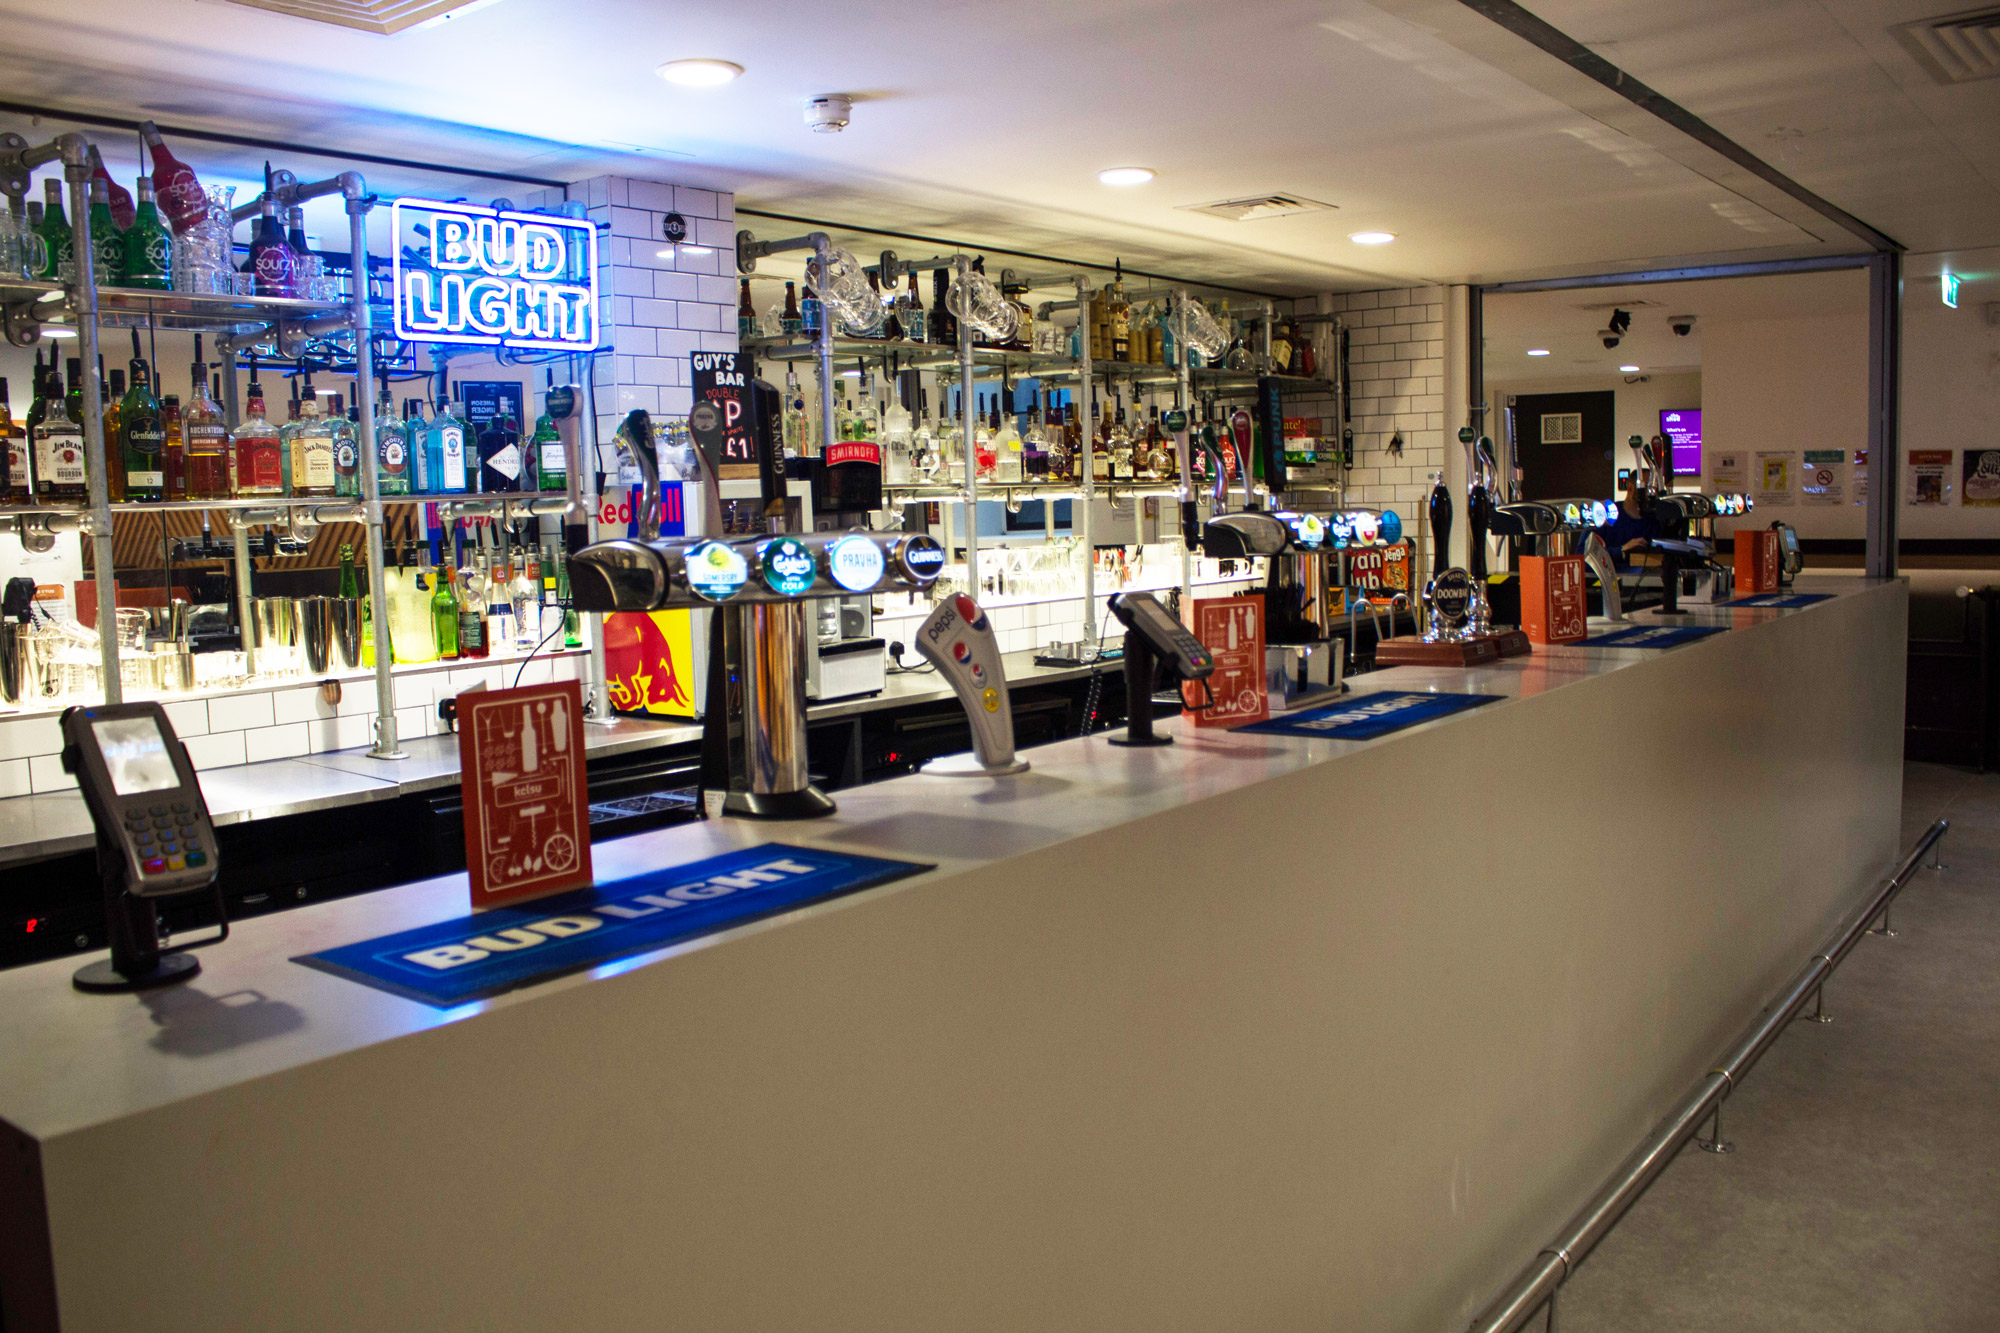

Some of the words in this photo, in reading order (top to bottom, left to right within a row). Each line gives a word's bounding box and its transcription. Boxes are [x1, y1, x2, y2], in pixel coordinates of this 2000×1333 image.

[430, 212, 566, 280] BUD
[405, 271, 590, 341] LIGHT
[693, 353, 735, 371] GUY'S
[715, 371, 745, 387] BAR
[706, 388, 740, 400] DOUBLE
[1271, 388, 1283, 446] PUNK
[52, 442, 65, 454] JIM
[380, 437, 404, 457] PLYMOUTH
[772, 413, 785, 474] GUINNESS
[831, 446, 875, 461] SMIRNOFF
[57, 470, 83, 478] BOURBON
[843, 552, 877, 568] PRAVHA
[909, 550, 944, 563] GUINNESS
[1384, 547, 1406, 562] Jenga
[773, 553, 811, 576] Carlsberg
[702, 572, 738, 583] SOMERSBY
[782, 582, 804, 590] COLD
[1437, 589, 1458, 599] DOOM
[928, 606, 957, 644] pepsi
[402, 915, 603, 970] BUD
[593, 859, 817, 919] LIGHT
